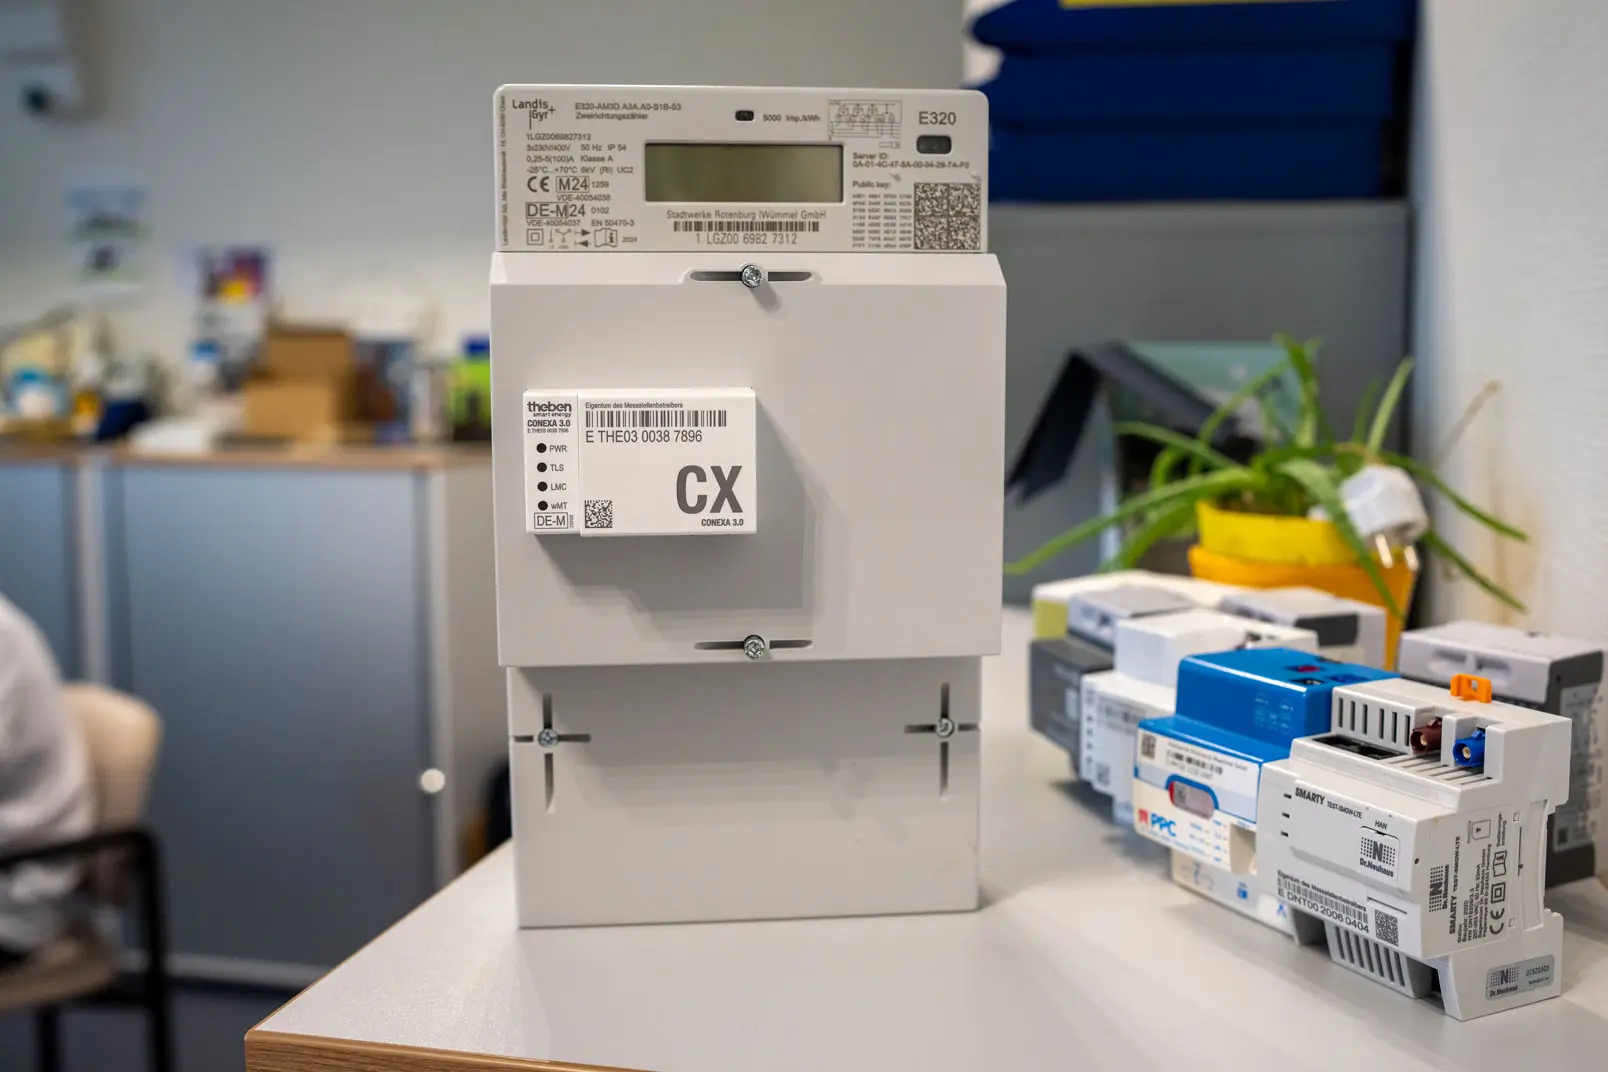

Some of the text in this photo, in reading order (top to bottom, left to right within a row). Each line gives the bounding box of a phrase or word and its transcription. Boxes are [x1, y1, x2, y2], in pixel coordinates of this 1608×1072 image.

[512, 99, 549, 109] Landis
[575, 111, 649, 121] Zweirichtungszähler
[763, 114, 782, 122] 5000
[918, 111, 957, 125] E320
[580, 144, 591, 152] 50
[592, 144, 603, 152] Hz
[607, 144, 616, 152] IP
[617, 144, 627, 152] 54
[852, 152, 877, 160] Server
[617, 166, 634, 174] UC2
[558, 178, 588, 191] M24
[852, 180, 892, 190] Public key:
[666, 209, 712, 219] Stadtwerke
[714, 209, 756, 221] Rotenburg
[800, 209, 827, 219] GmbH
[591, 219, 602, 227] EN
[706, 233, 739, 245] LGZ00
[743, 233, 768, 245] 6982
[772, 233, 798, 245] 7312
[527, 401, 572, 412] theben
[585, 402, 612, 410] Eigentum
[527, 419, 571, 427] CONEXA 3.0
[585, 430, 703, 443] E THE03 0038 7896
[549, 445, 568, 453] PWR
[550, 464, 565, 472] TLS
[550, 483, 567, 491] LMC
[676, 465, 743, 514] CX
[551, 502, 568, 510] wMT
[536, 515, 566, 527] DE-M
[701, 519, 744, 527] CONEXA 3.0
[1295, 787, 1326, 805] SMARTY
[1151, 812, 1177, 837] PPC
[1375, 820, 1388, 830] HAN
[1360, 857, 1394, 877] Dr.Neuhaus
[1301, 880, 1311, 889] des
[1278, 888, 1370, 934] E DNT00 2006 0404
[1449, 896, 1457, 934] SMARTY
